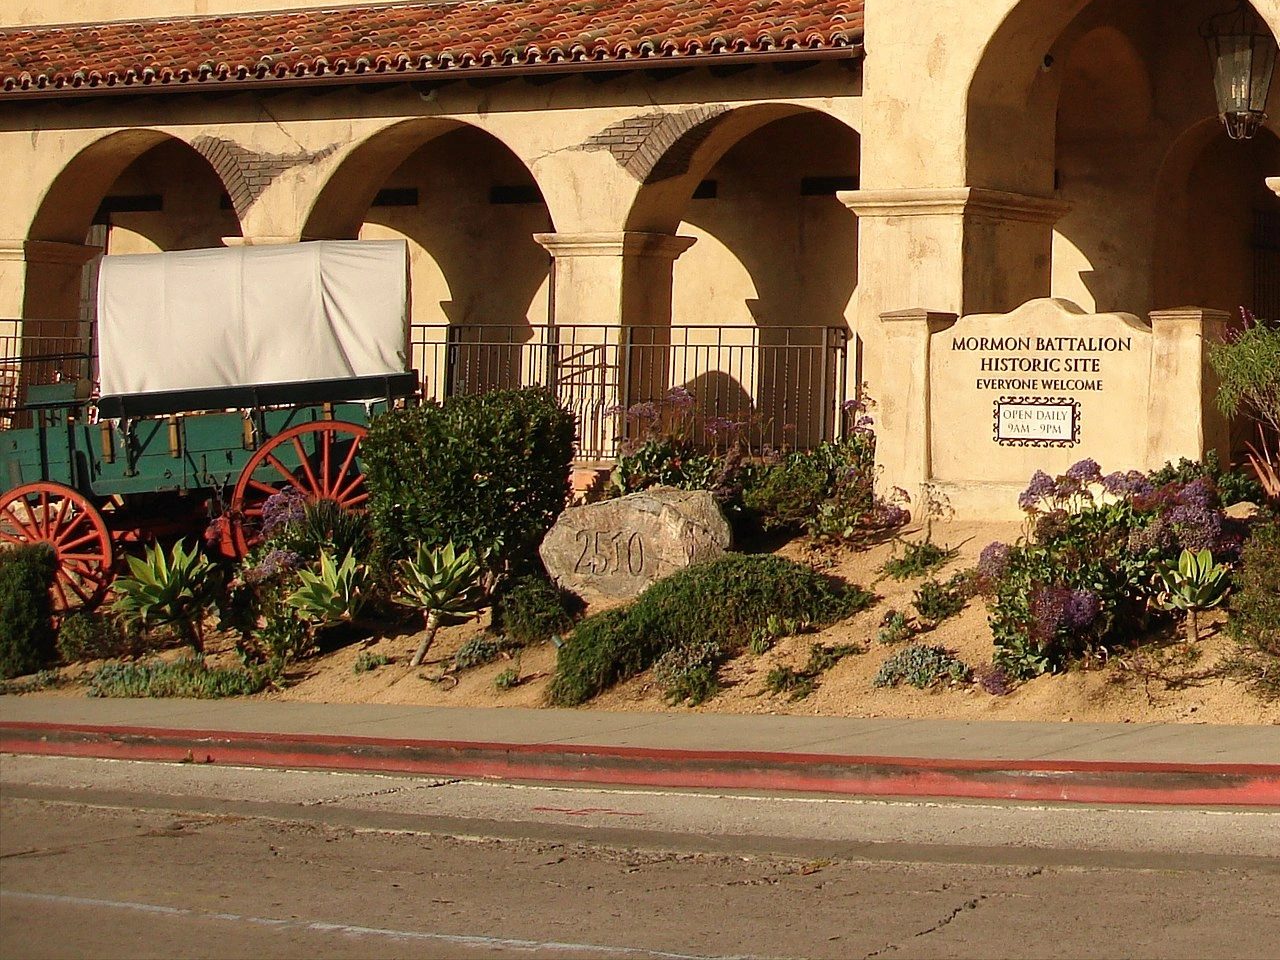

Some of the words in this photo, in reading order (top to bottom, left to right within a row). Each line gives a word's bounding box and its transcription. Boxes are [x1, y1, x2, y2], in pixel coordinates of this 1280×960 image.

[951, 337, 1031, 351] MORMON
[1035, 337, 1132, 352] BATTALION
[981, 357, 1061, 372] HISTORIC
[1064, 358, 1100, 373] SITE
[976, 379, 1038, 390] EVERYONE
[1041, 379, 1103, 391] WELCOME
[1003, 409, 1033, 420] OPEN
[1036, 410, 1068, 421] DAILY
[1008, 424, 1030, 434] 9AM
[1040, 424, 1062, 434] 9PM
[574, 529, 644, 577] 2510
